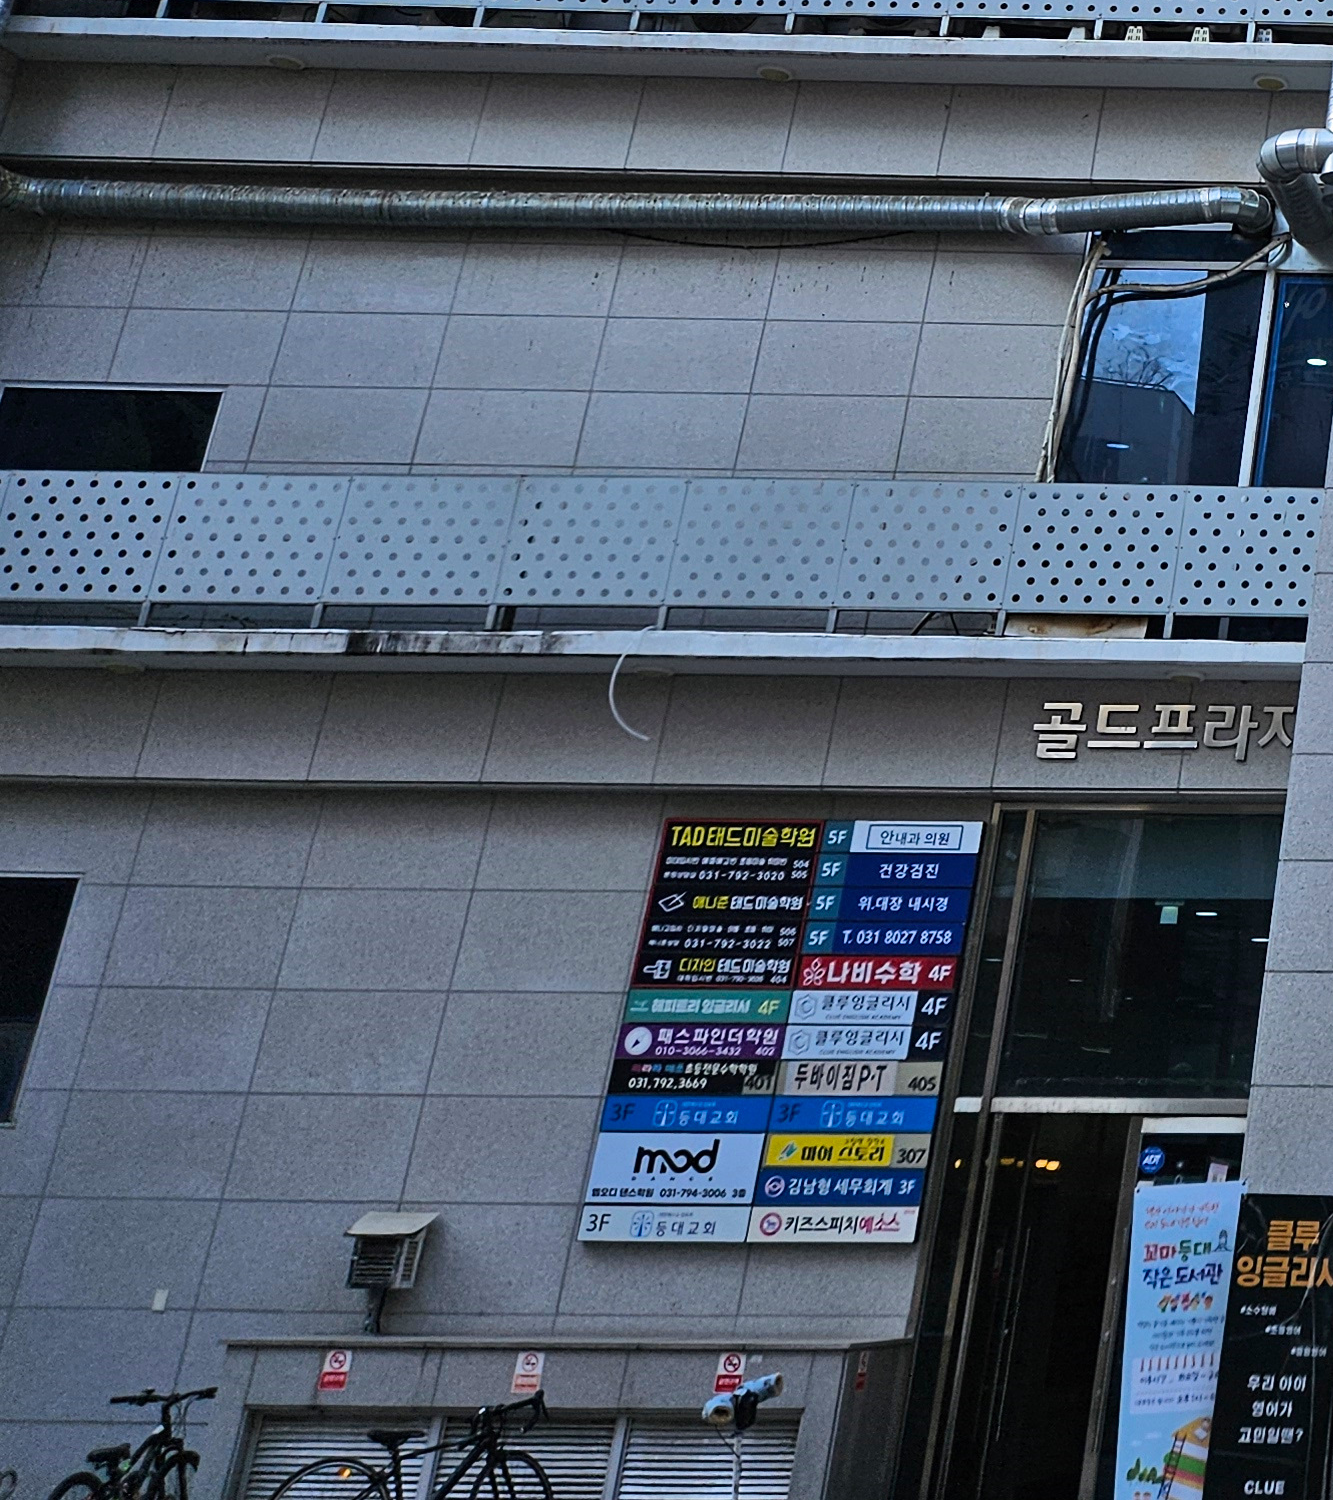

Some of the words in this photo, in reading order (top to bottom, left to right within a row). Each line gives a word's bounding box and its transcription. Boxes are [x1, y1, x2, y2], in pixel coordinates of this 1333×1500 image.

[827, 829, 850, 845] 5F
[880, 829, 921, 846] 안내과
[923, 831, 951, 847] 의원
[821, 861, 843, 878] 5F
[878, 863, 940, 879] 건강검진
[815, 895, 837, 911] 5F
[907, 896, 950, 912] 내시경
[808, 929, 831, 946] 5F
[856, 929, 882, 945] 031
[883, 929, 917, 945] 8027
[919, 929, 953, 945] 8758
[677, 957, 717, 973] 디자인
[826, 959, 924, 985] 나비수학
[928, 964, 953, 982] 4F
[651, 998, 700, 1014] 해피트리
[701, 998, 752, 1015] 잉글리시
[757, 999, 782, 1016] 4F
[821, 993, 913, 1011] 클루잉글리시
[920, 996, 949, 1016] 4F
[657, 1027, 780, 1046] 패스파인더학원
[815, 1029, 907, 1047] 클루잉글리시
[914, 1031, 943, 1051] 4F
[743, 1075, 775, 1092] 401
[907, 1075, 938, 1093] 405
[609, 1102, 637, 1123] 3F
[678, 1109, 740, 1127] 등대교회
[776, 1102, 803, 1123] 3F
[845, 1110, 906, 1128] 등대교회
[632, 1138, 721, 1175] mod
[896, 1148, 927, 1164] 307
[1142, 1152, 1163, 1166] ADT
[659, 1187, 728, 1199] 031-794-3006
[789, 1177, 832, 1196] 김남형
[833, 1177, 894, 1197] 세무회계
[897, 1179, 917, 1196] 3F
[585, 1213, 612, 1233] 3F
[656, 1221, 717, 1238] 등대교회
[1266, 1220, 1321, 1253] 클루
[1247, 1373, 1275, 1393] 우리
[1278, 1373, 1308, 1393] 아이
[1252, 1399, 1294, 1419] 영어가
[1243, 1479, 1286, 1496] CLUE
